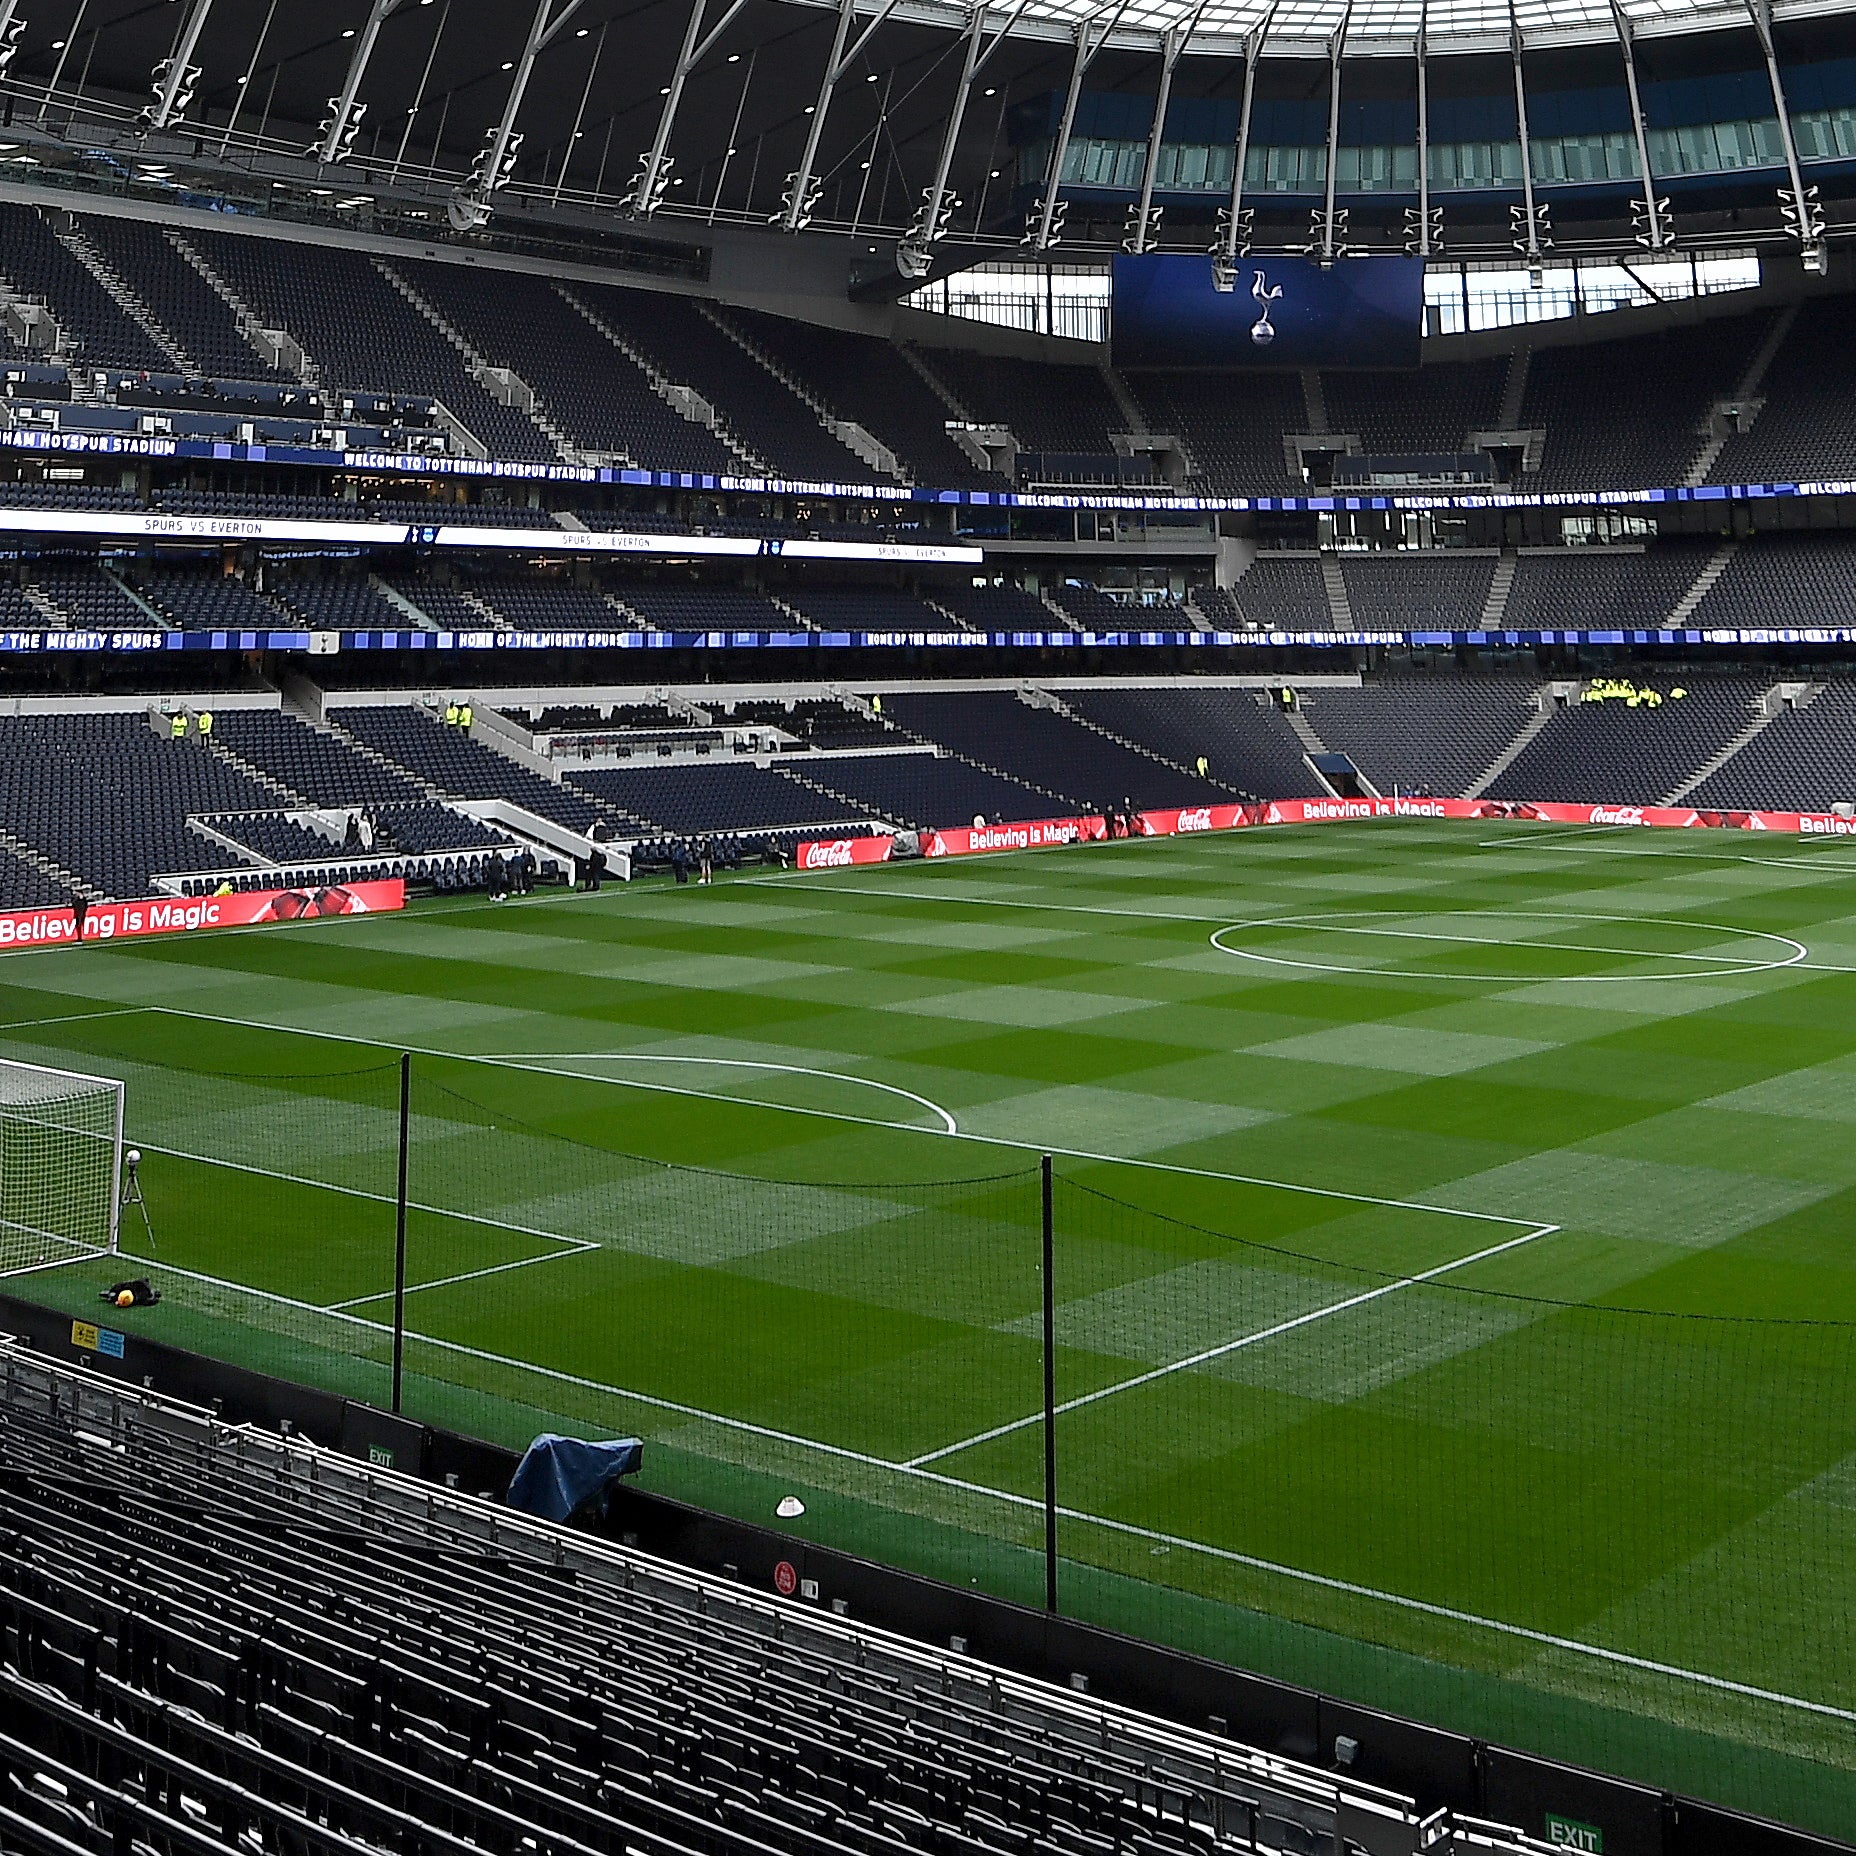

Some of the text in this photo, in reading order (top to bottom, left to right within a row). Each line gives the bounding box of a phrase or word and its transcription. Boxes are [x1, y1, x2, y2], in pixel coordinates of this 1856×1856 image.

[40, 432, 108, 452] HOTSPUR
[113, 436, 175, 455] STADIUM
[344, 452, 596, 482] WELCOME TO TOTTENHAM HOTSPUR STADIUM
[720, 476, 911, 500] WELCOME TO TOTTENHAM HOTSPUR STADIUM
[1017, 494, 1248, 510] WELCOME TO TOTTENHAM HOTSPUR STADIUM
[1393, 490, 1650, 509] WELCOME TO TOTTENHAM HOTSPUR STADIUM
[144, 519, 262, 534] SPURS VS EVERTON
[9, 633, 40, 650] THE
[46, 633, 108, 650] MIGHTY
[112, 633, 162, 650] SPURS
[458, 632, 622, 648] HOME OF THE MIGHTY SPURS
[1302, 800, 1445, 819] Believing is Magic
[969, 827, 1028, 850] Believing
[1029, 825, 1041, 843] is
[121, 907, 143, 932] is
[149, 900, 220, 931] Magic
[369, 1449, 392, 1468] EXIT
[1550, 1821, 1597, 1852] EXIT
